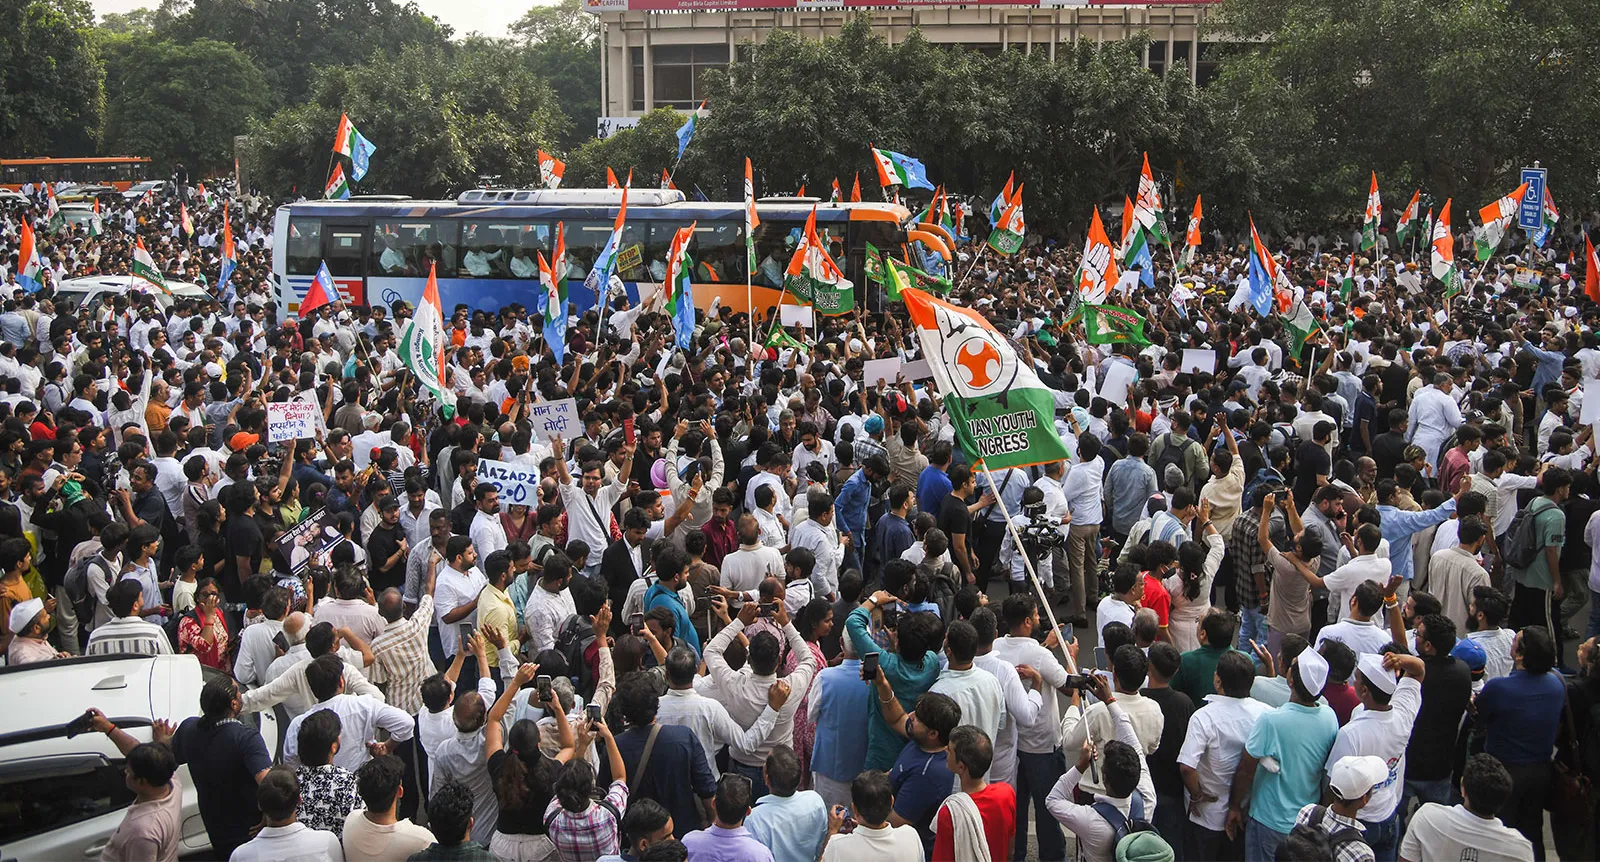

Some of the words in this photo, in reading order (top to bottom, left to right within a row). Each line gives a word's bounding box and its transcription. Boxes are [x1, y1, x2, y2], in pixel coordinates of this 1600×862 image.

[533, 404, 552, 416] मान
[555, 403, 568, 412] जा
[544, 415, 569, 432] मोदी
[993, 410, 1037, 433] YOUTH
